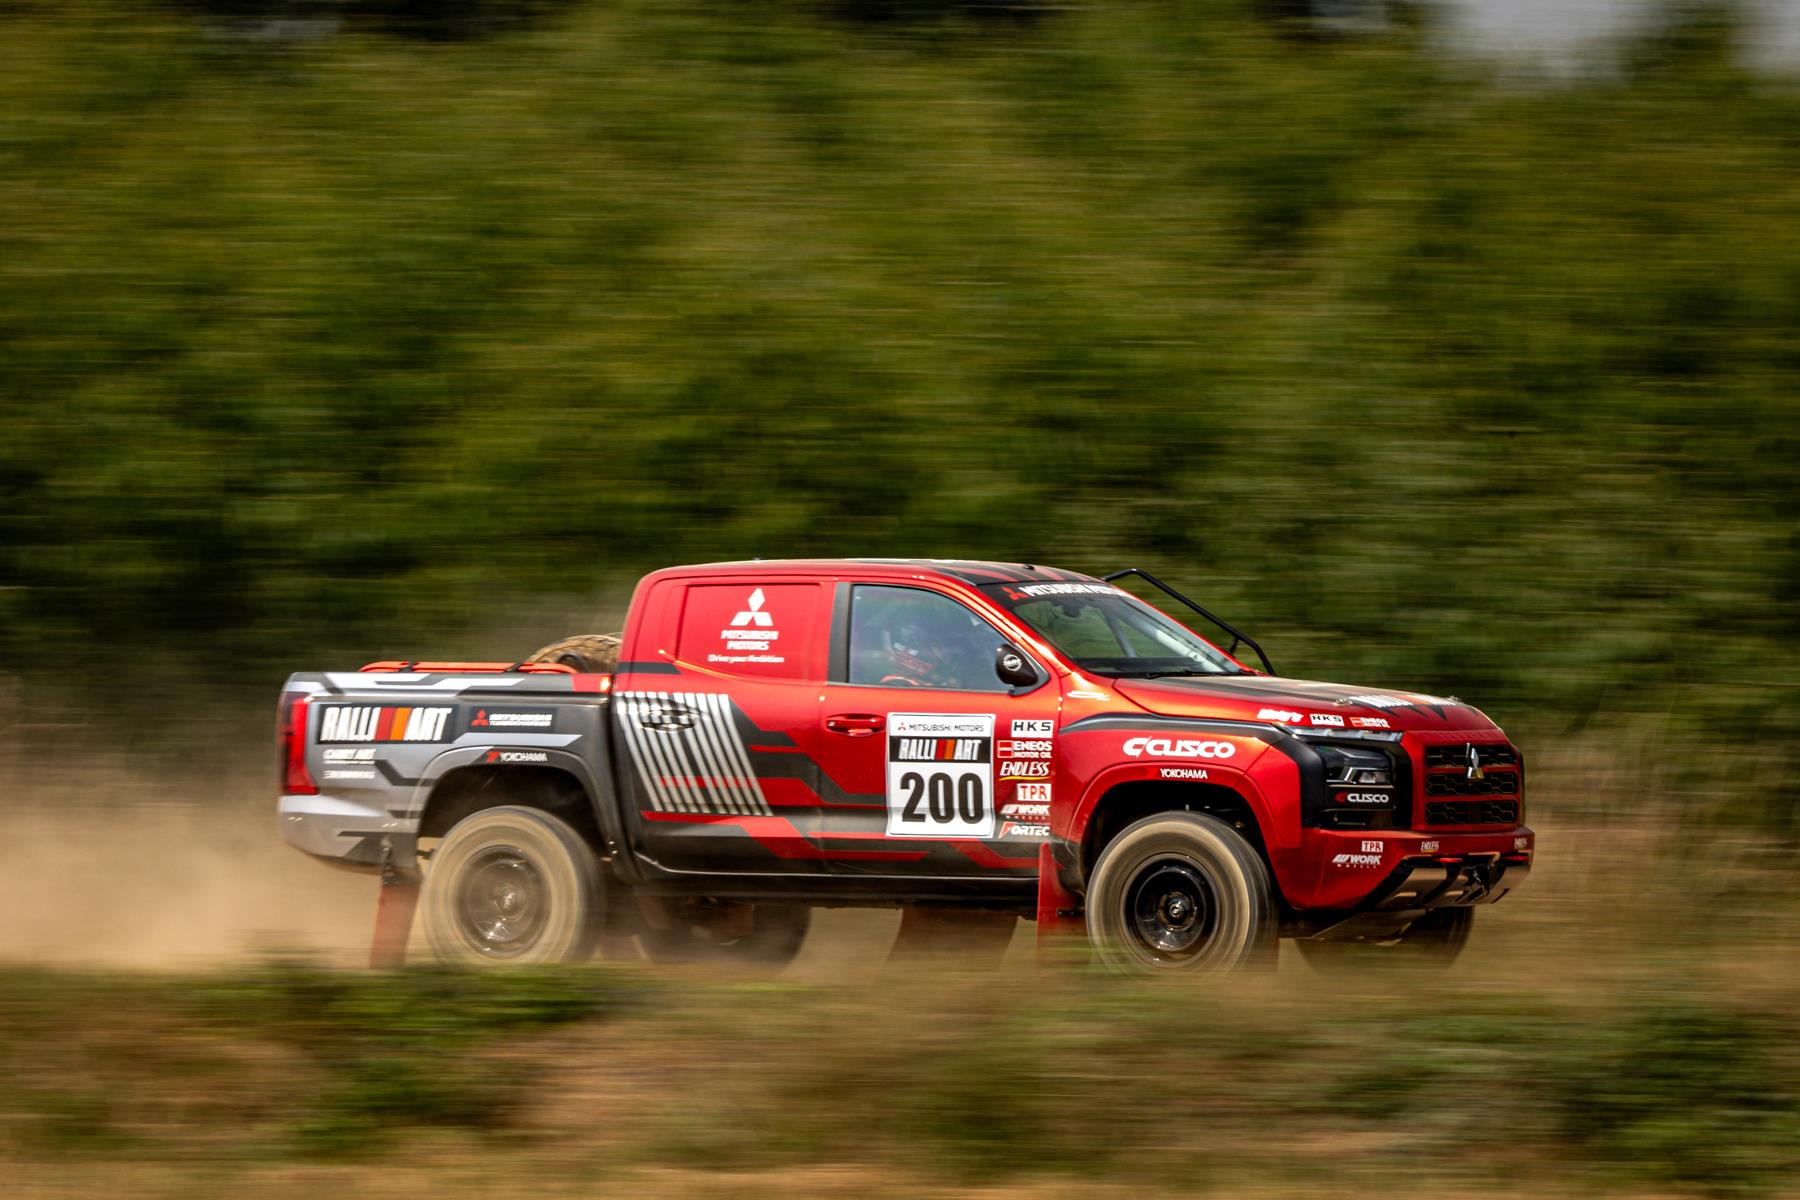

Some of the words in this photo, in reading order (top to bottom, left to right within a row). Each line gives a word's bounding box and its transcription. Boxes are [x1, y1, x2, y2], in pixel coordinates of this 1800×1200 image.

[1013, 721, 1051, 731] HKS
[1013, 740, 1052, 751] ENEOS
[500, 752, 548, 761] YOKOHAMA
[1000, 761, 1051, 776] ENDLESS
[1160, 768, 1208, 779] YOKOHAMA
[1020, 785, 1047, 799] TPR
[900, 772, 984, 824] 200
[1347, 793, 1389, 803] CUSCO
[1350, 855, 1382, 865] WORK
